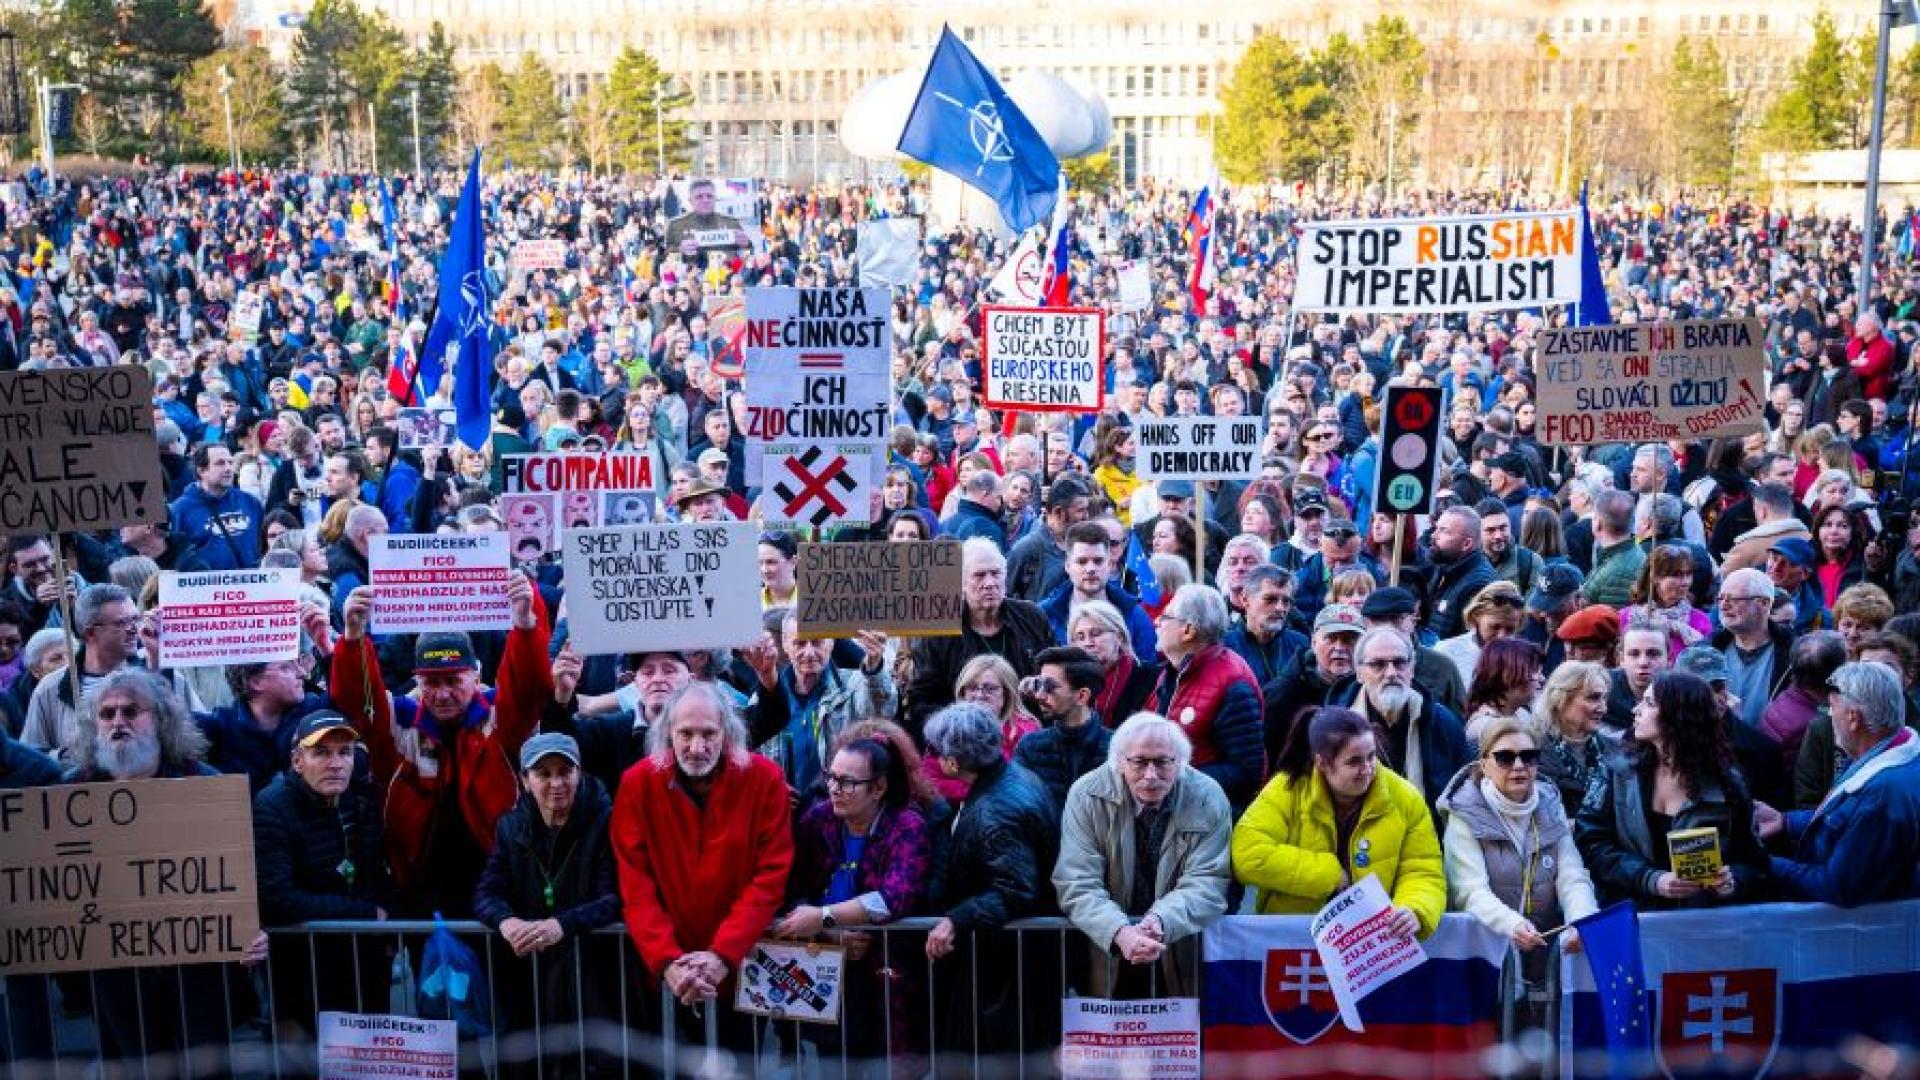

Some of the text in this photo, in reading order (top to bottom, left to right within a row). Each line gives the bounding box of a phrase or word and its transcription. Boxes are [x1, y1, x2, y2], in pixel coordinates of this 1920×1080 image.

[1313, 228, 1401, 266] STOP
[1324, 259, 1554, 306] IMPERIALISM
[747, 316, 886, 348] NEČINNOSŤ
[994, 314, 1043, 335] CHCEM
[1649, 327, 1675, 350] ICH
[1683, 323, 1751, 348] BRATIA
[1596, 357, 1616, 381] SA
[1623, 355, 1650, 378] ONI
[804, 375, 846, 406] ICH
[747, 402, 888, 441] ZLOČINNOSŤ
[1140, 424, 1257, 446] HANDS OFF OUR
[0, 443, 97, 485] ALE
[501, 451, 652, 491] FICOMPÁNIA
[1151, 451, 1253, 473] DEMOCRACY
[1394, 484, 1415, 500] EU
[578, 527, 729, 554] SMER HLAS SNS
[423, 556, 456, 567] FICO
[685, 552, 720, 572] DNO
[908, 541, 955, 568] OPICE
[908, 570, 929, 592] DO
[213, 590, 246, 601] FICO
[1, 788, 137, 832] FICO
[0, 856, 236, 904] TINOV TROLL
[109, 915, 243, 959] REKTOFIL
[1113, 1021, 1147, 1032] FICO
[372, 1035, 405, 1047] FICO
